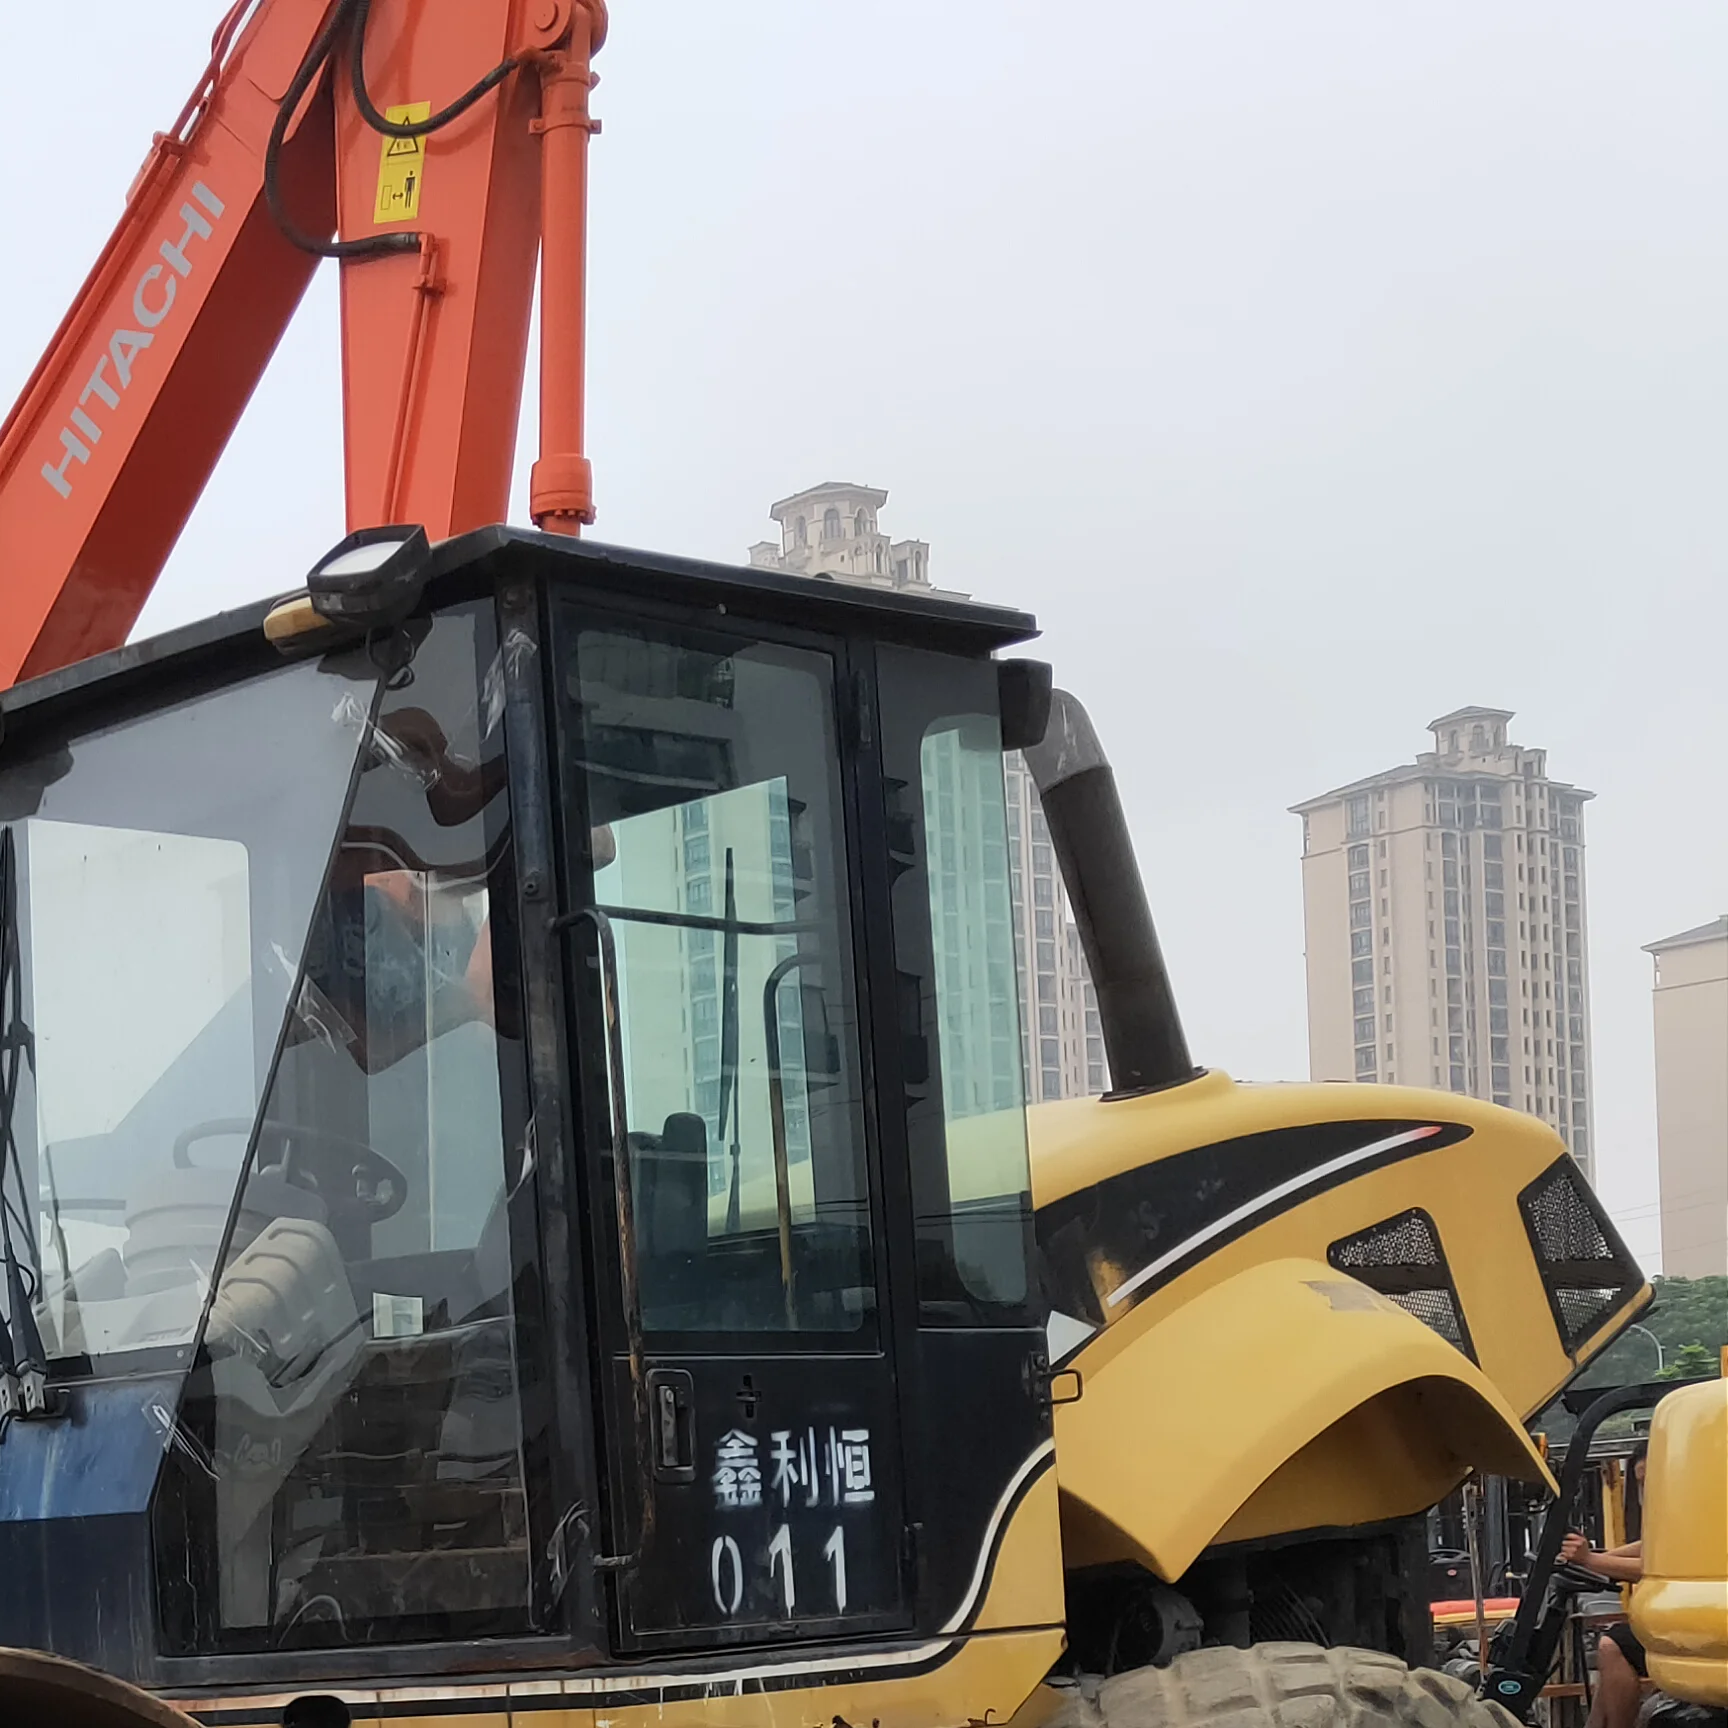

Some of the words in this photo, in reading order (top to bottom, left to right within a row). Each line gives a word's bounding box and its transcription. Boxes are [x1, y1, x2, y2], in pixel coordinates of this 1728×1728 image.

[41, 180, 225, 499] HITACHI
[712, 1426, 875, 1508] 鑫利恒
[712, 1523, 847, 1618] 011
